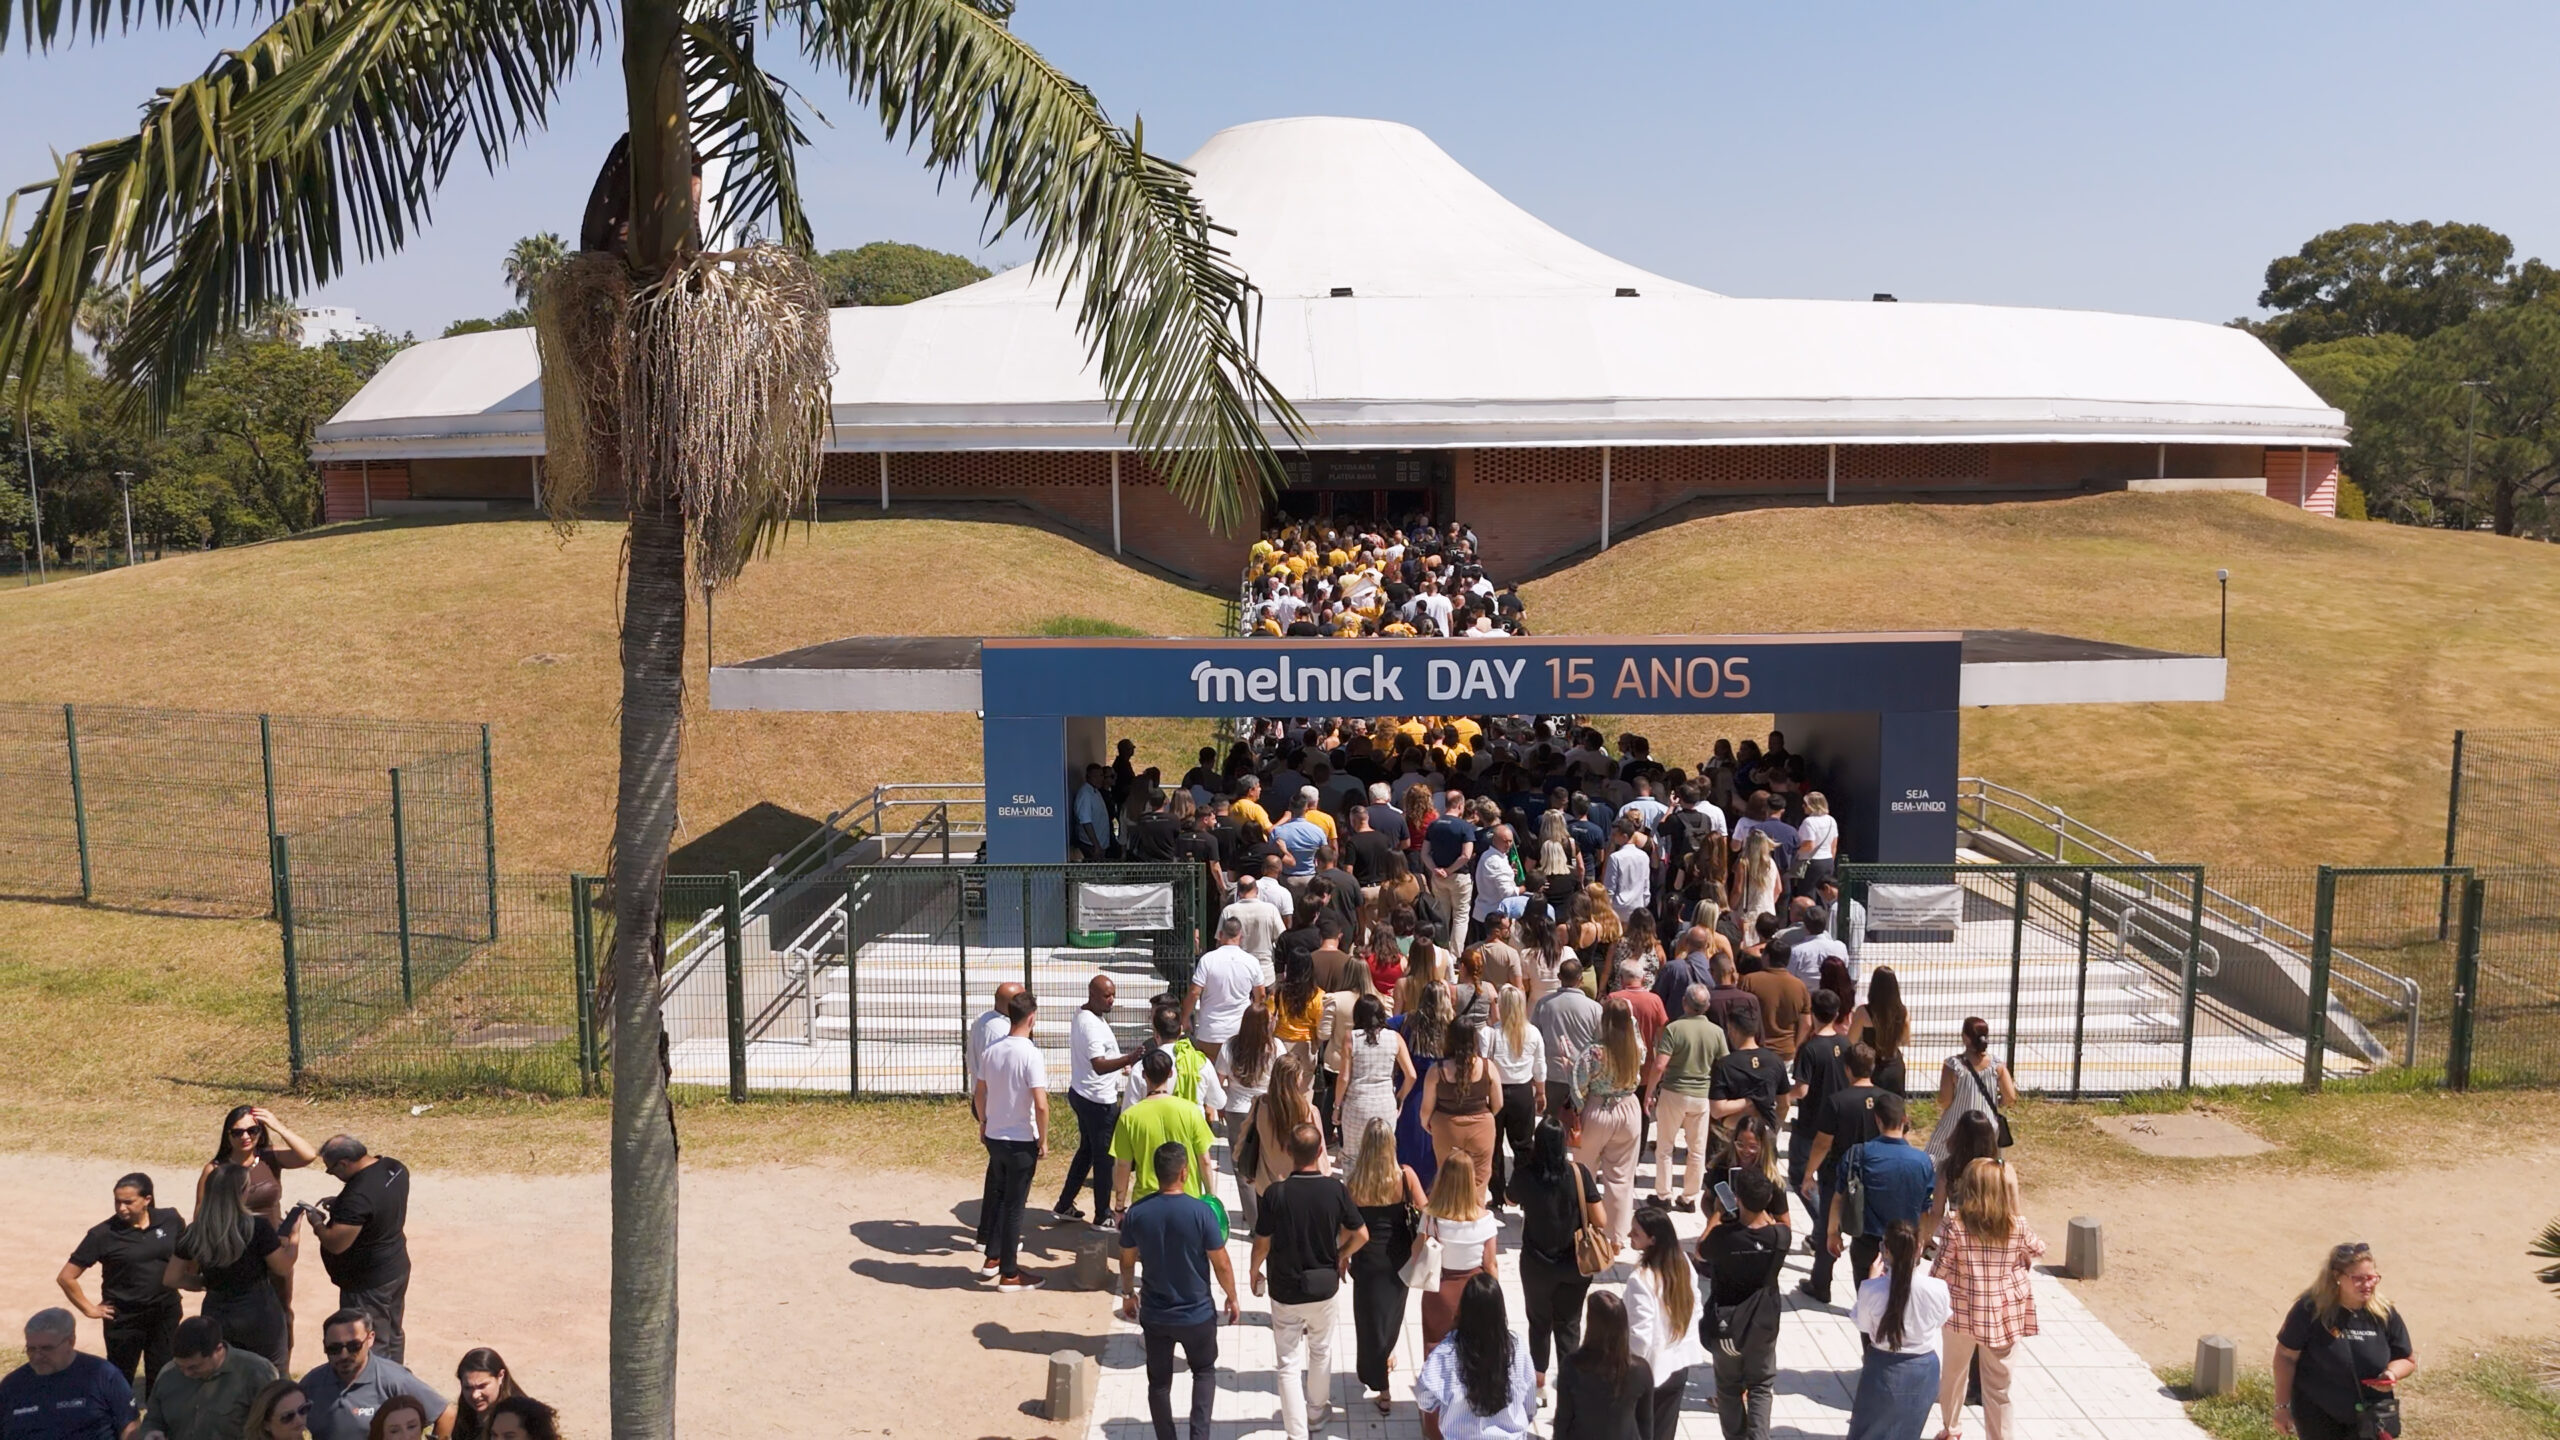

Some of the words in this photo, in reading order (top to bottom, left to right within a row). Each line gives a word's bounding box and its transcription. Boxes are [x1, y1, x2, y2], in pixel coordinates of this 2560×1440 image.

[1190, 654, 1404, 703] melnick
[1427, 658, 1526, 701] DAY
[1545, 657, 1595, 700] 15
[1612, 656, 1750, 699] ANOS
[1012, 794, 1036, 804] SEJA
[1906, 789, 1929, 799] SEJA
[998, 806, 1053, 816] BEM-VINDO
[1891, 801, 1946, 811] BEM-VINDO
